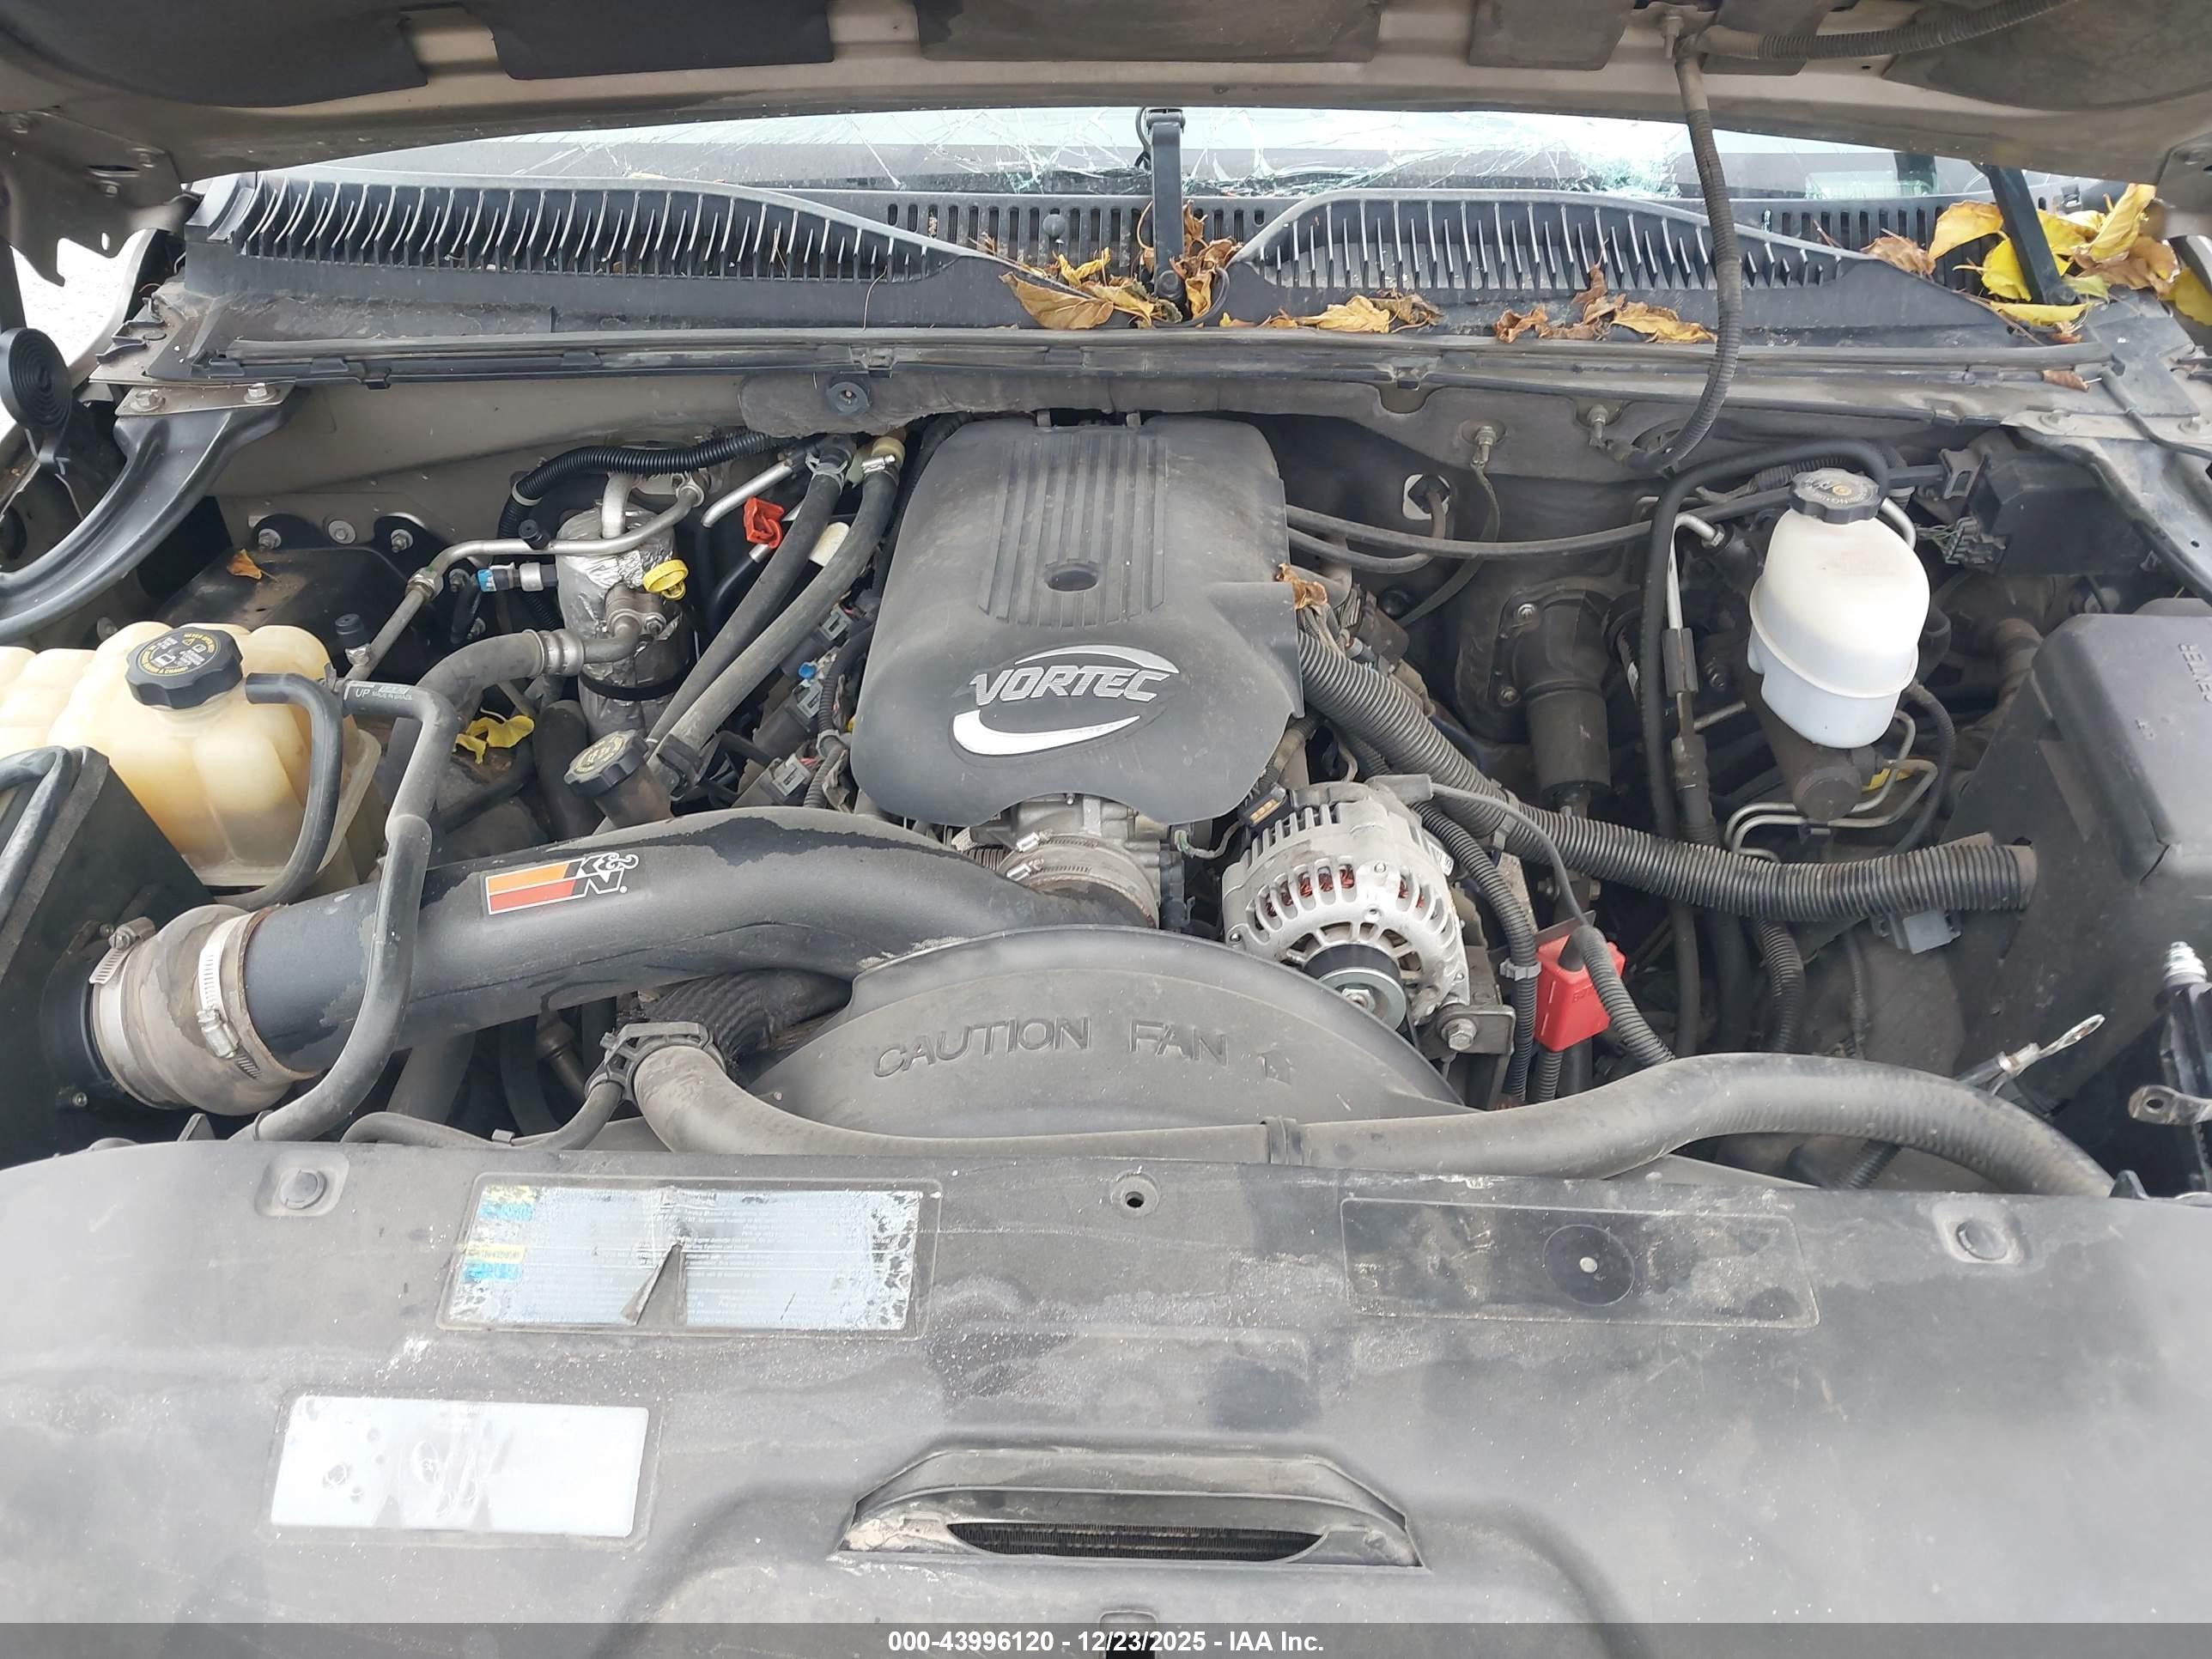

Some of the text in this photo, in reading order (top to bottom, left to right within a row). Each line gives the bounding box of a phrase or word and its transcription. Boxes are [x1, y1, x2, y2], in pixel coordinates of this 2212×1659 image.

[355, 687, 371, 698] UP
[969, 665, 1170, 707] VORTEC
[564, 853, 640, 896] K&N
[873, 1017, 1230, 1079] CAUTION FAN
